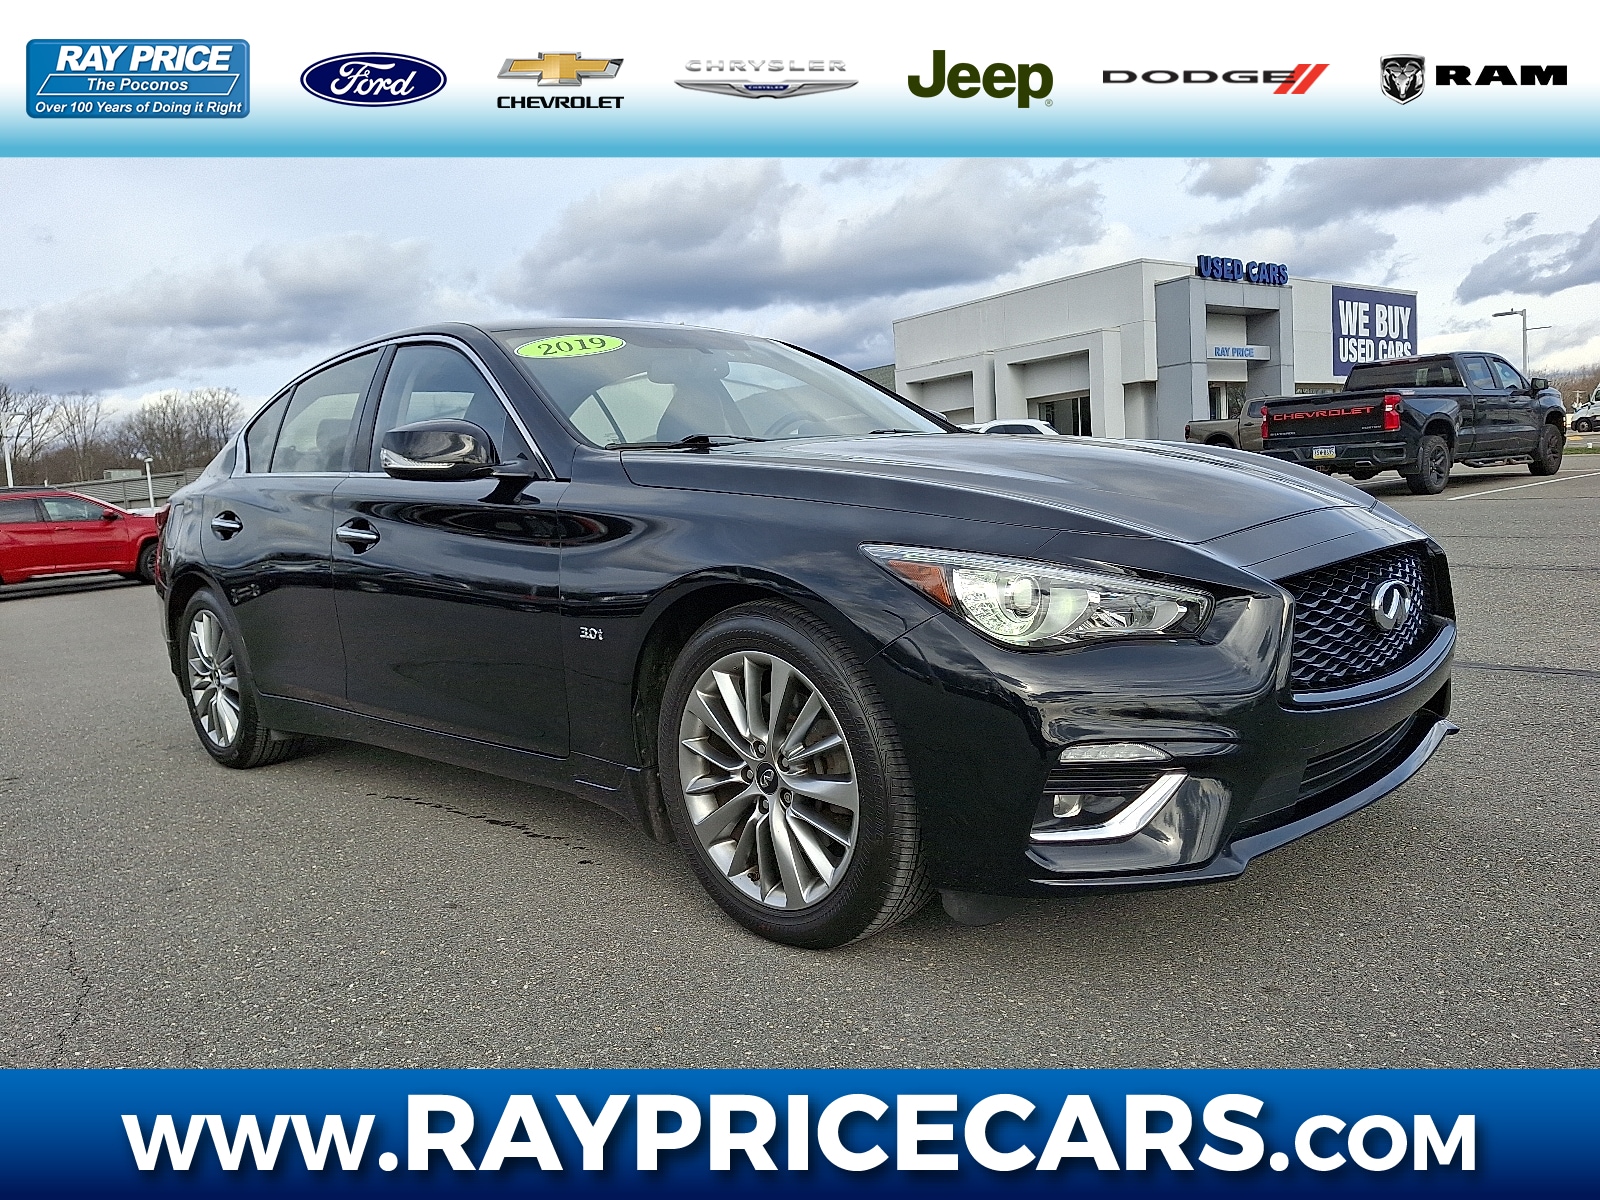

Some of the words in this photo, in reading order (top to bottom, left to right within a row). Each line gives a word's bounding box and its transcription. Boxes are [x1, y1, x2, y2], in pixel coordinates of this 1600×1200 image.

[1197, 255, 1244, 281] USED
[1246, 261, 1289, 285] CARS
[1338, 300, 1370, 337] WE
[1375, 303, 1412, 340] BUY
[537, 337, 607, 356] 2019
[1214, 346, 1230, 357] RAY
[1231, 347, 1255, 358] PRICE
[1339, 337, 1375, 363] USED
[1378, 340, 1412, 360] CARS
[1273, 406, 1375, 421] CHEVROLET
